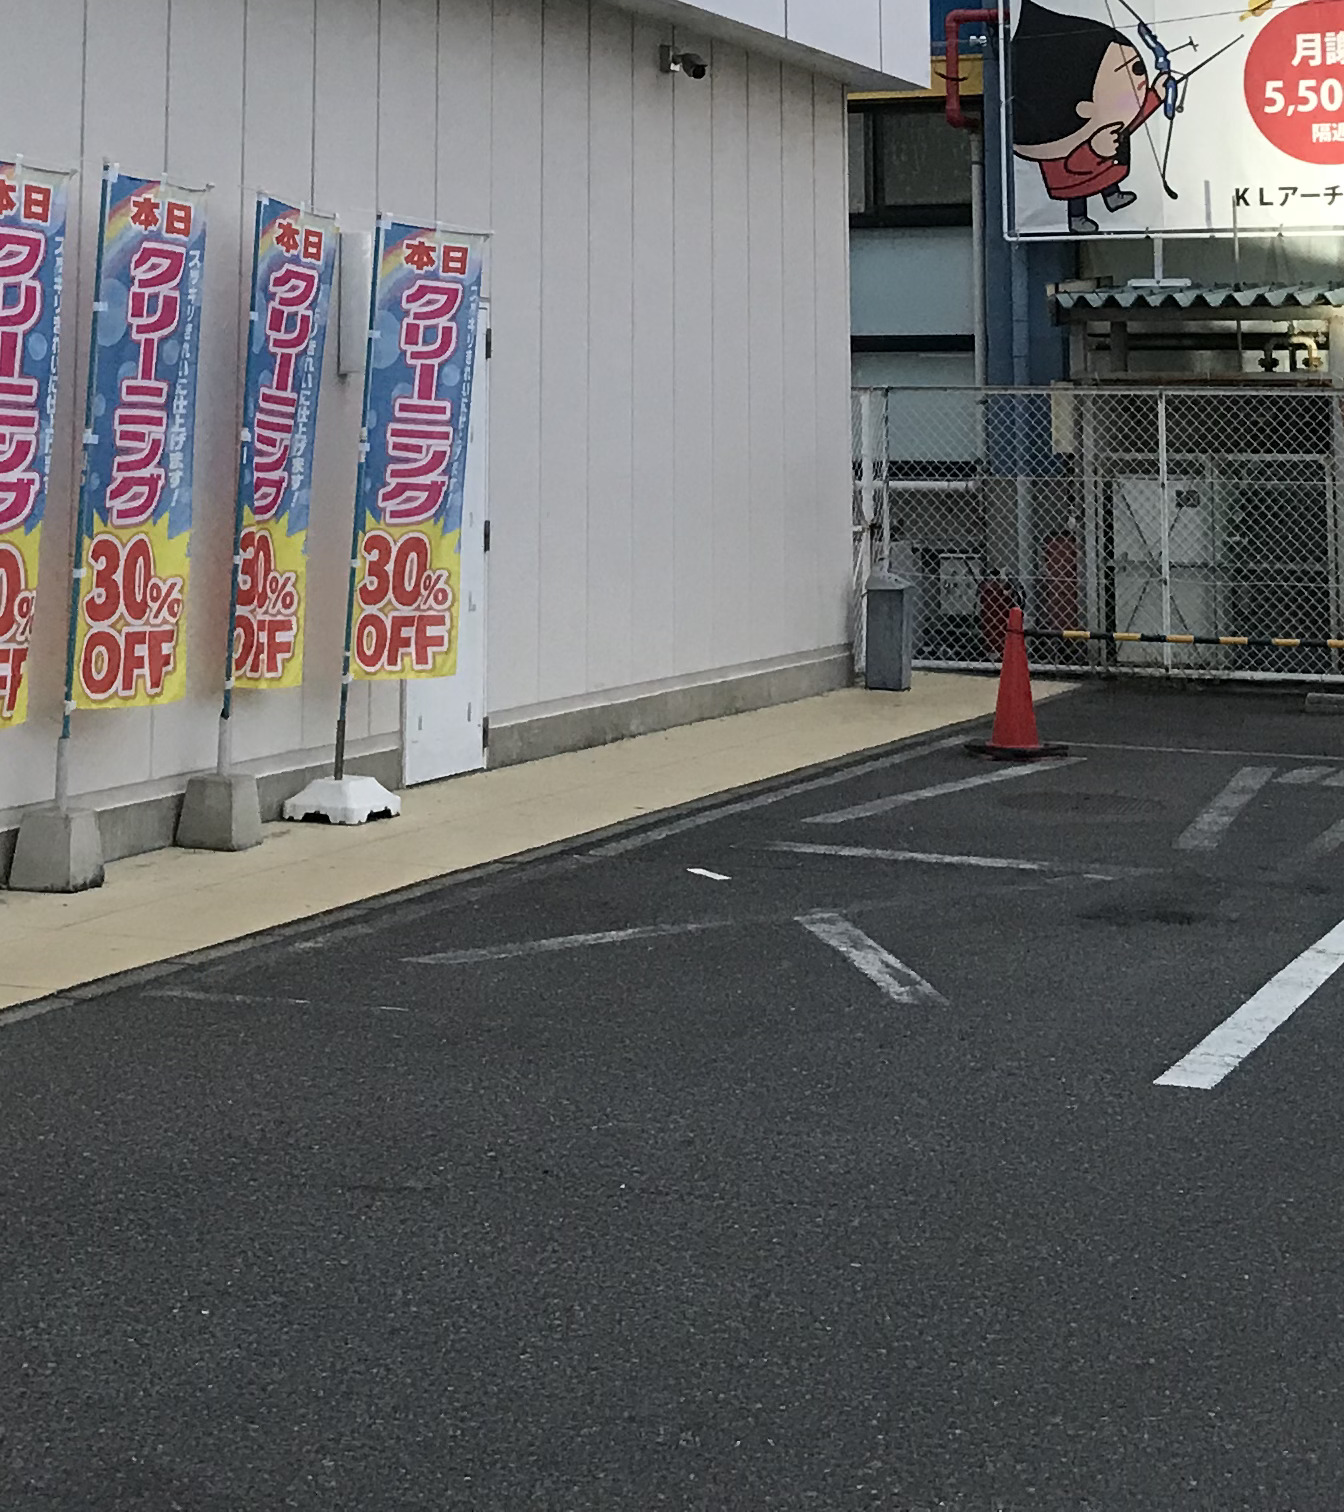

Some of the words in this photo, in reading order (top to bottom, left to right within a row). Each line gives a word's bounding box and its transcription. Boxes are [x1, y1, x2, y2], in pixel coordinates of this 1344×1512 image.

[130, 193, 193, 238] 本日
[274, 218, 324, 263] 本日
[403, 238, 470, 277] 本日
[107, 240, 187, 525] クリーニング
[254, 263, 318, 521] クリーニング
[377, 279, 463, 524] クリーニング
[83, 534, 183, 626] 30%
[237, 526, 297, 615] 30%
[358, 529, 452, 611] 30%
[80, 625, 176, 700] OFF
[233, 614, 296, 677] OFF
[356, 609, 450, 673] OFF
